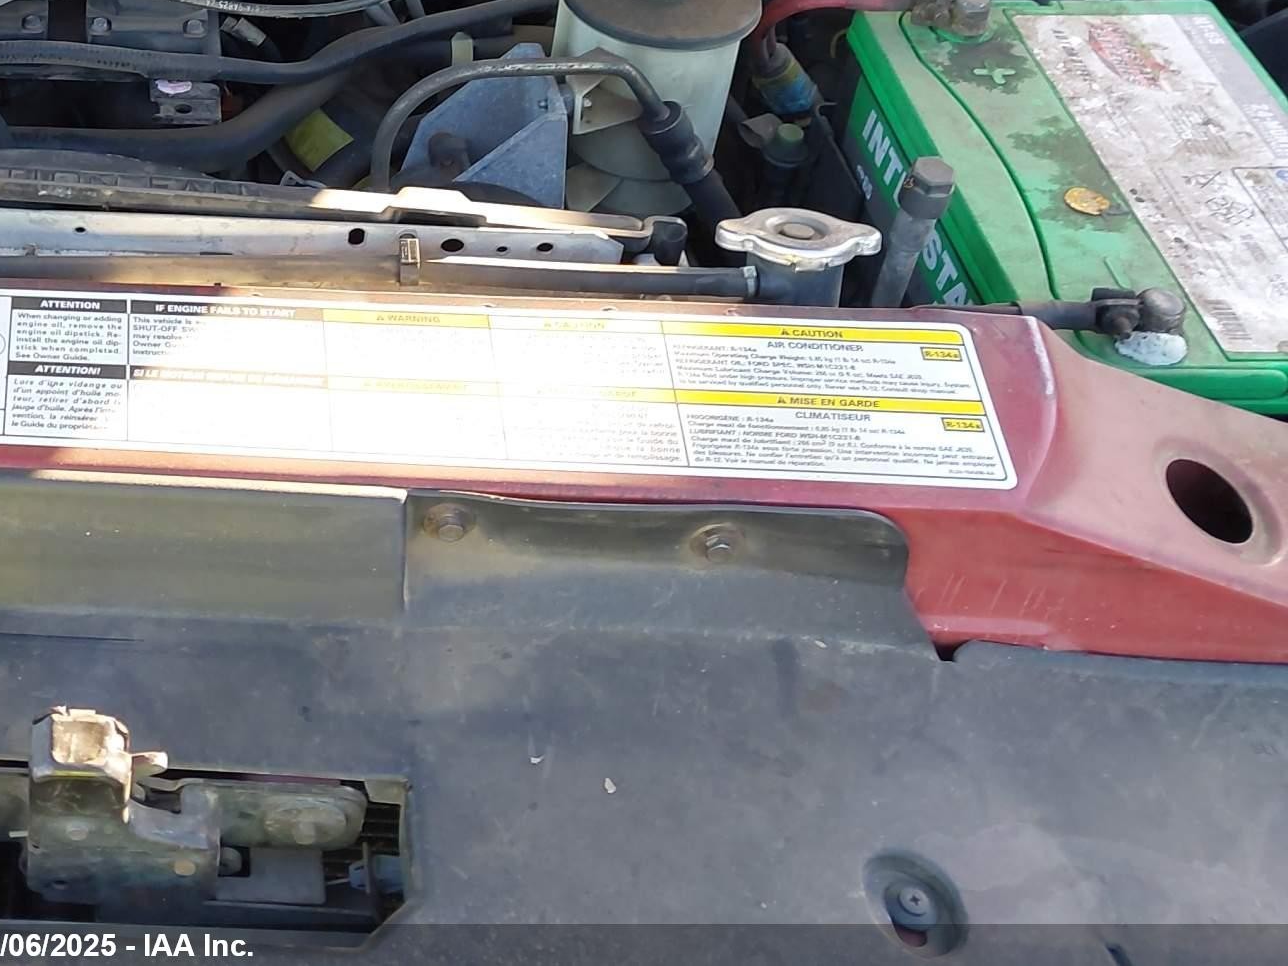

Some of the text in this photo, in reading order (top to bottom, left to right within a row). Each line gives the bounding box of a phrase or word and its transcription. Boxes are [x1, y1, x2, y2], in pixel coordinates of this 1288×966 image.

[40, 300, 100, 309] ATTENTION
[155, 303, 295, 318] IF ENGINE FAILS TO START
[43, 313, 80, 321] changing
[93, 314, 121, 322] adding
[17, 320, 47, 328] engine
[68, 322, 103, 330] remove
[132, 323, 177, 332] SHUT-OFF
[16, 328, 46, 336] engine
[64, 330, 103, 338] dipstick.
[792, 329, 843, 337] CAUTION
[60, 337, 88, 345] engine
[69, 346, 120, 354] completed.
[787, 342, 863, 351] CONDITIONER
[62, 353, 89, 361] Guide.
[924, 350, 958, 358] R-134a
[34, 364, 100, 375] ATTENTION!
[790, 397, 816, 405] MISE
[838, 399, 881, 407] GARDE
[794, 411, 871, 421] CLIMATISEUR
